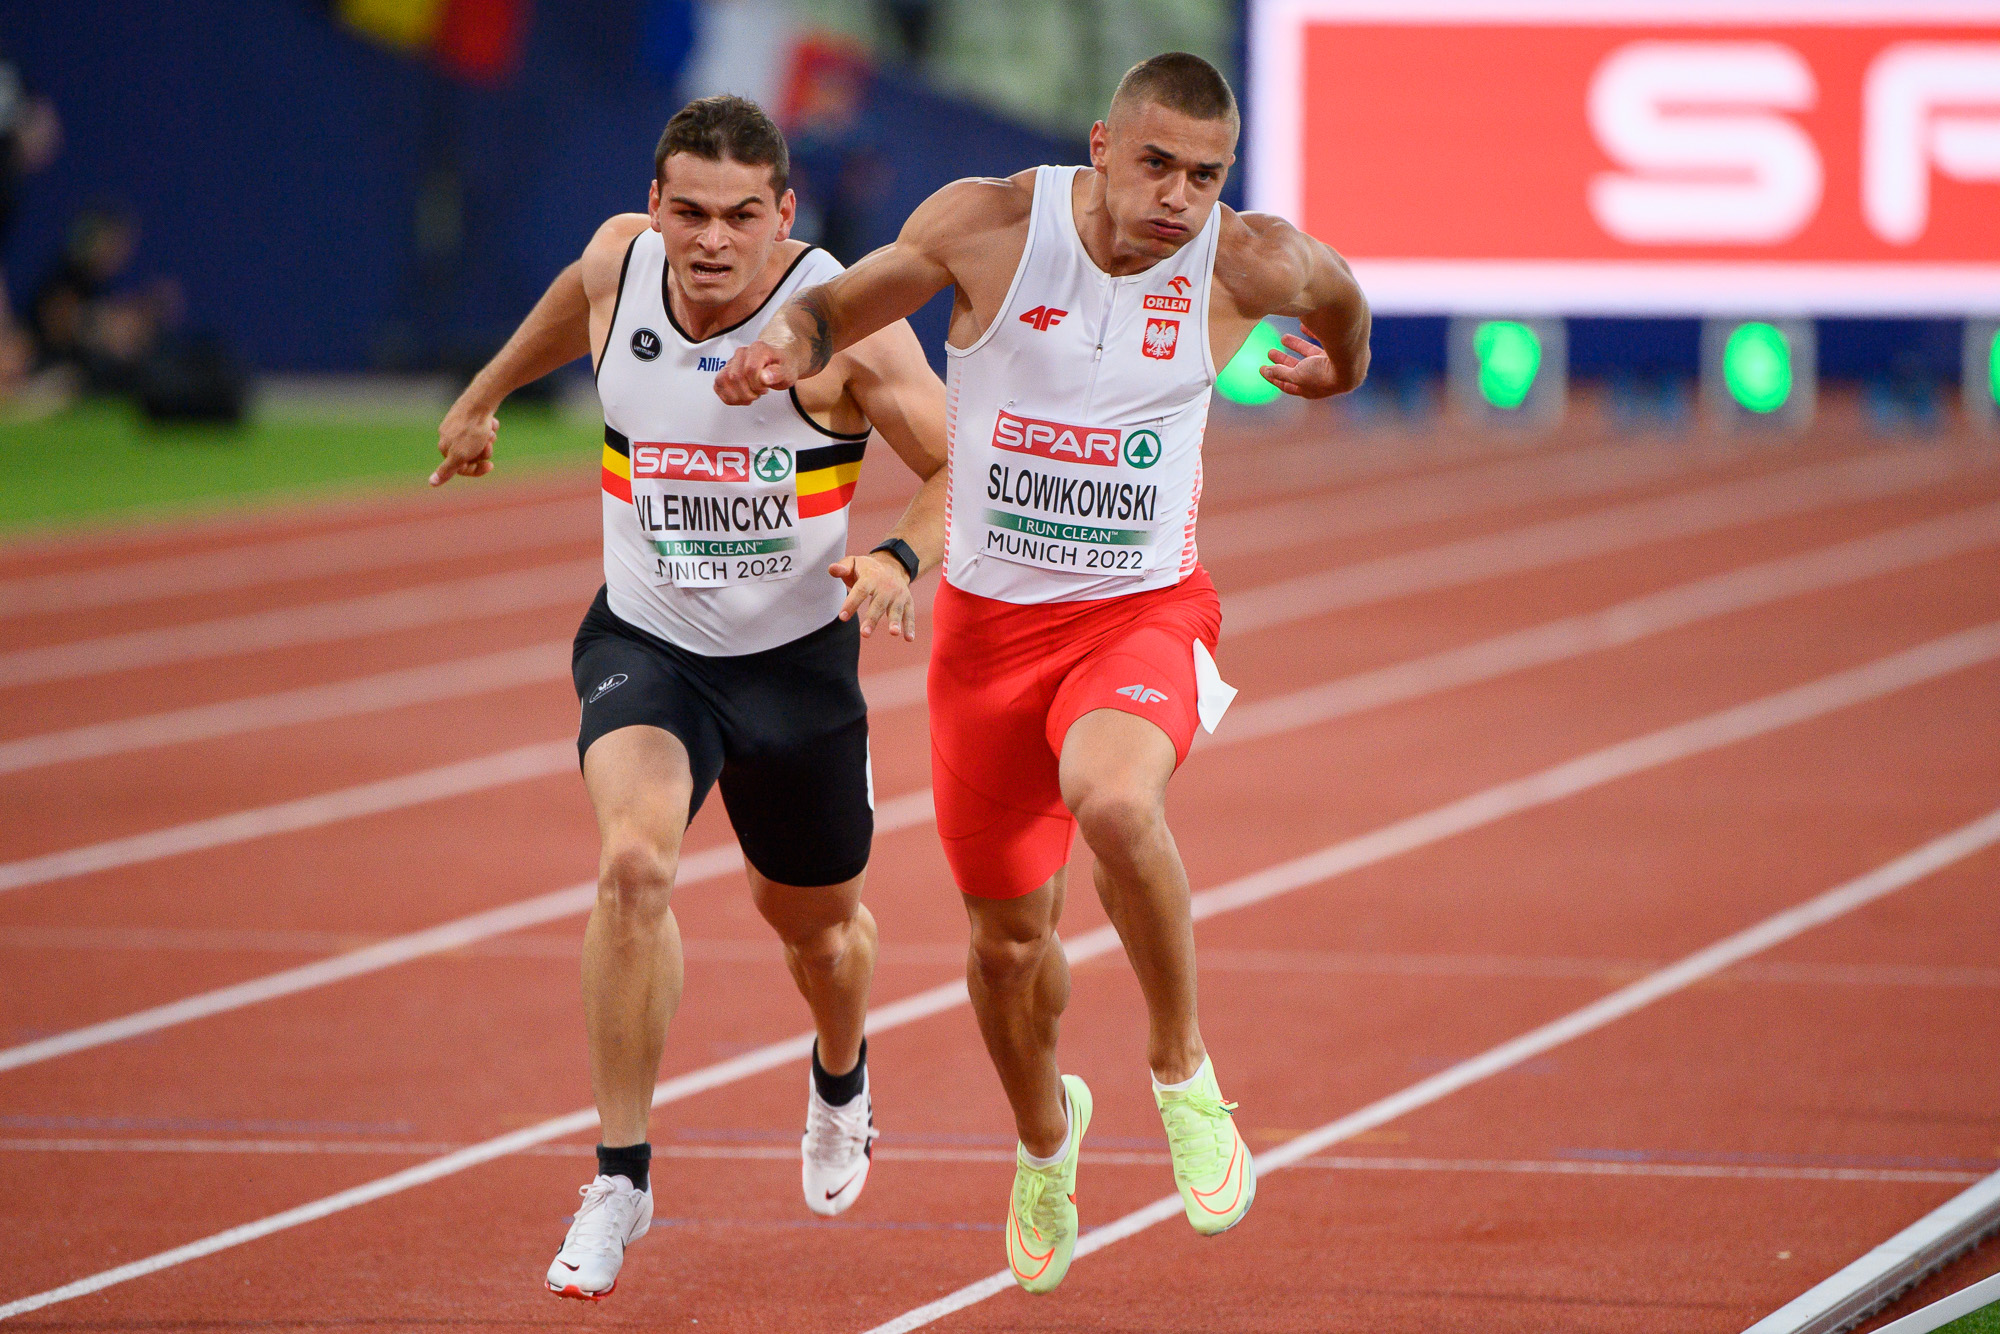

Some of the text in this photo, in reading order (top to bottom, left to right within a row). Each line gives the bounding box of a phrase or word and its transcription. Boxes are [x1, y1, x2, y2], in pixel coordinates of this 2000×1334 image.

[1146, 297, 1188, 311] ORLEN
[1019, 305, 1068, 331] 4F
[697, 357, 727, 372] Allia
[996, 416, 1117, 462] SPAR
[635, 447, 746, 477] SPAR
[987, 463, 1158, 521] SLOWIKOWSKI
[635, 494, 793, 532] VLEMINCKX
[1018, 518, 1023, 530] I
[1026, 520, 1058, 538] RUN
[666, 542, 671, 554] I
[674, 542, 706, 555] RUN
[987, 530, 1143, 570] MUNICH 2022
[737, 555, 793, 579] 2022
[1116, 684, 1168, 704] 4F
